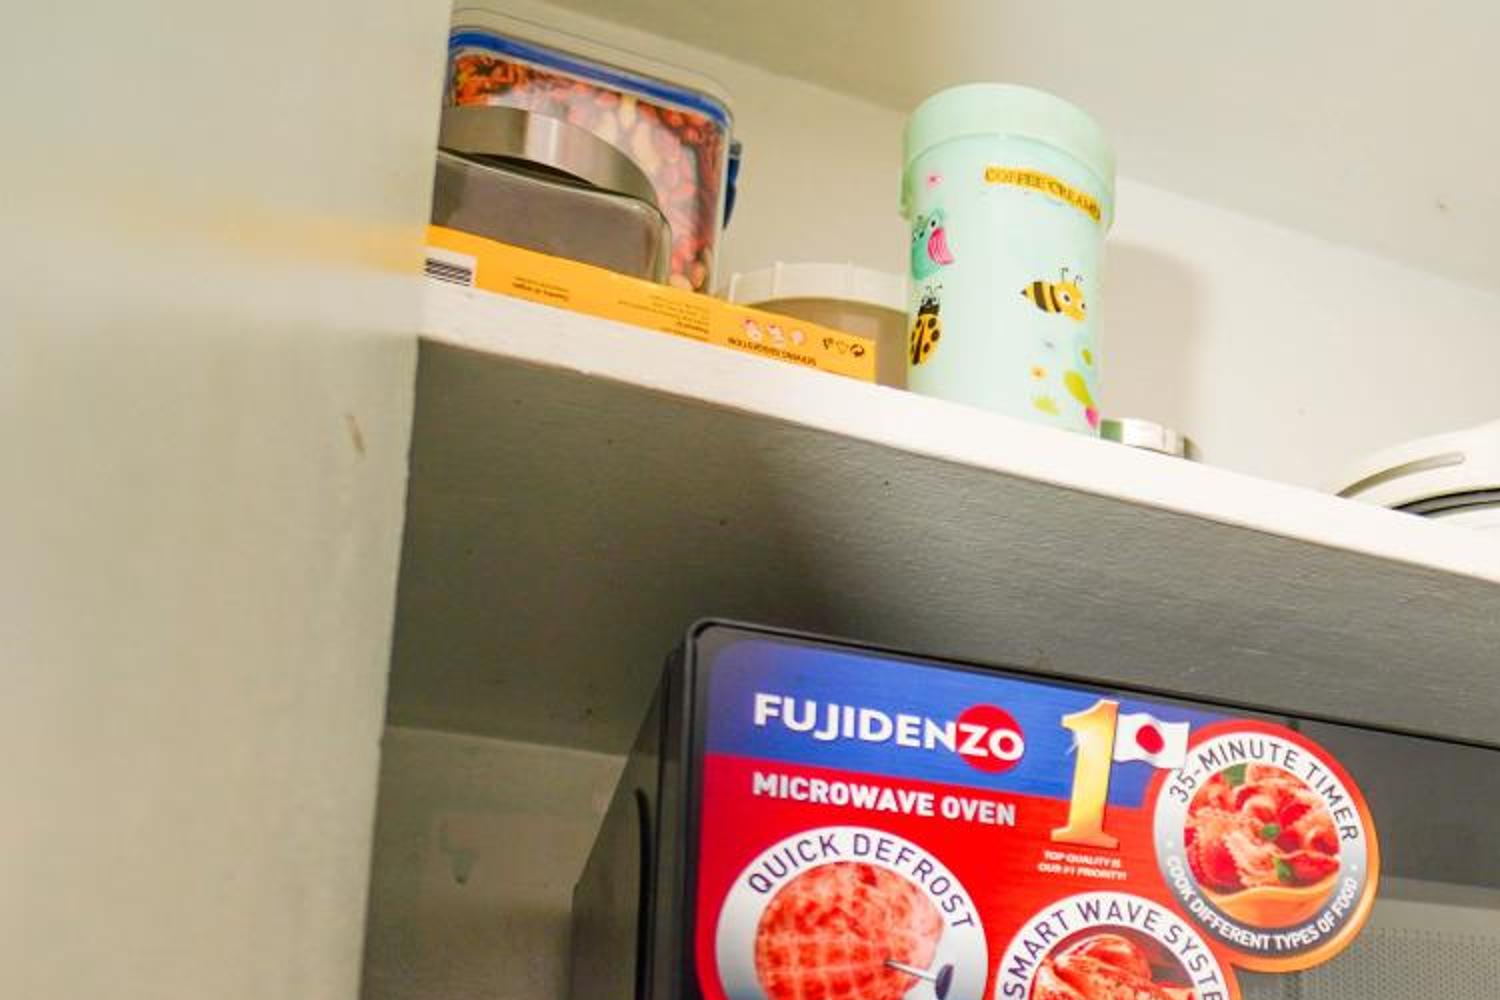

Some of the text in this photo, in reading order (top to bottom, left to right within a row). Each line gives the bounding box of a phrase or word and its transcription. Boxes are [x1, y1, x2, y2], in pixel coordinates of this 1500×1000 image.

[985, 167, 1046, 192] COFFEE
[754, 693, 1025, 761] FUJIDENZO
[752, 771, 1016, 827] MICROWAVE OVEN
[1169, 738, 1359, 841] 35-MINUTE TIMER
[748, 833, 976, 928] QUICK DEFROST
[1167, 855, 1359, 950] COOK DIFFERENT TYPES OF FOOD
[1003, 909, 1071, 1000] SMART
[1077, 899, 1162, 932] WAVE
